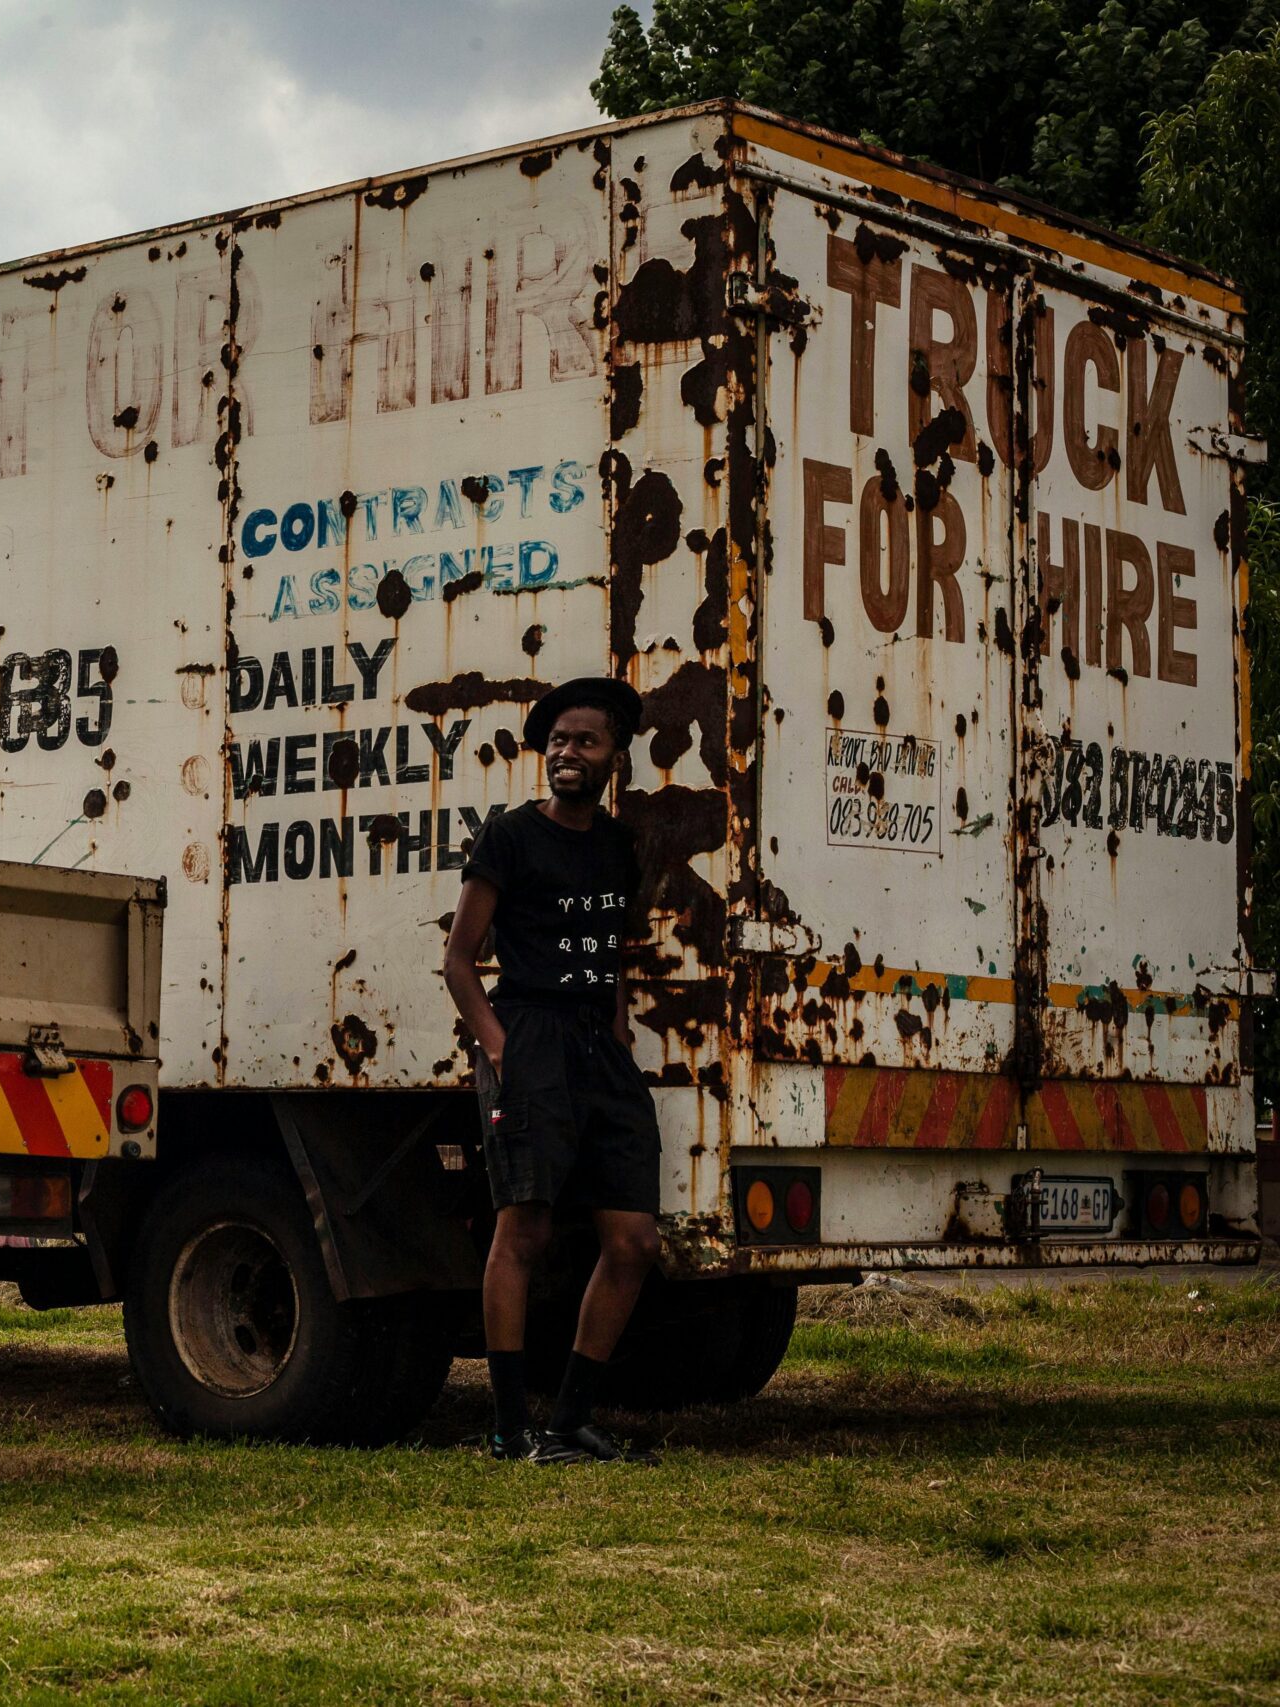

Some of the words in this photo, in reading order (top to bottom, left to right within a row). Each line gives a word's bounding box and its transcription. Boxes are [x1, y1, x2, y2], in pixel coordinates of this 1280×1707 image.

[309, 190, 650, 426] HIR
[827, 233, 1187, 516] TRUCK
[241, 461, 588, 558] CONTRACTS
[803, 458, 967, 644] FOR
[269, 540, 560, 623] ASSGNED
[1037, 511, 1198, 688] HIRE
[230, 637, 399, 714] DAILY
[230, 719, 473, 801] WEEKLY
